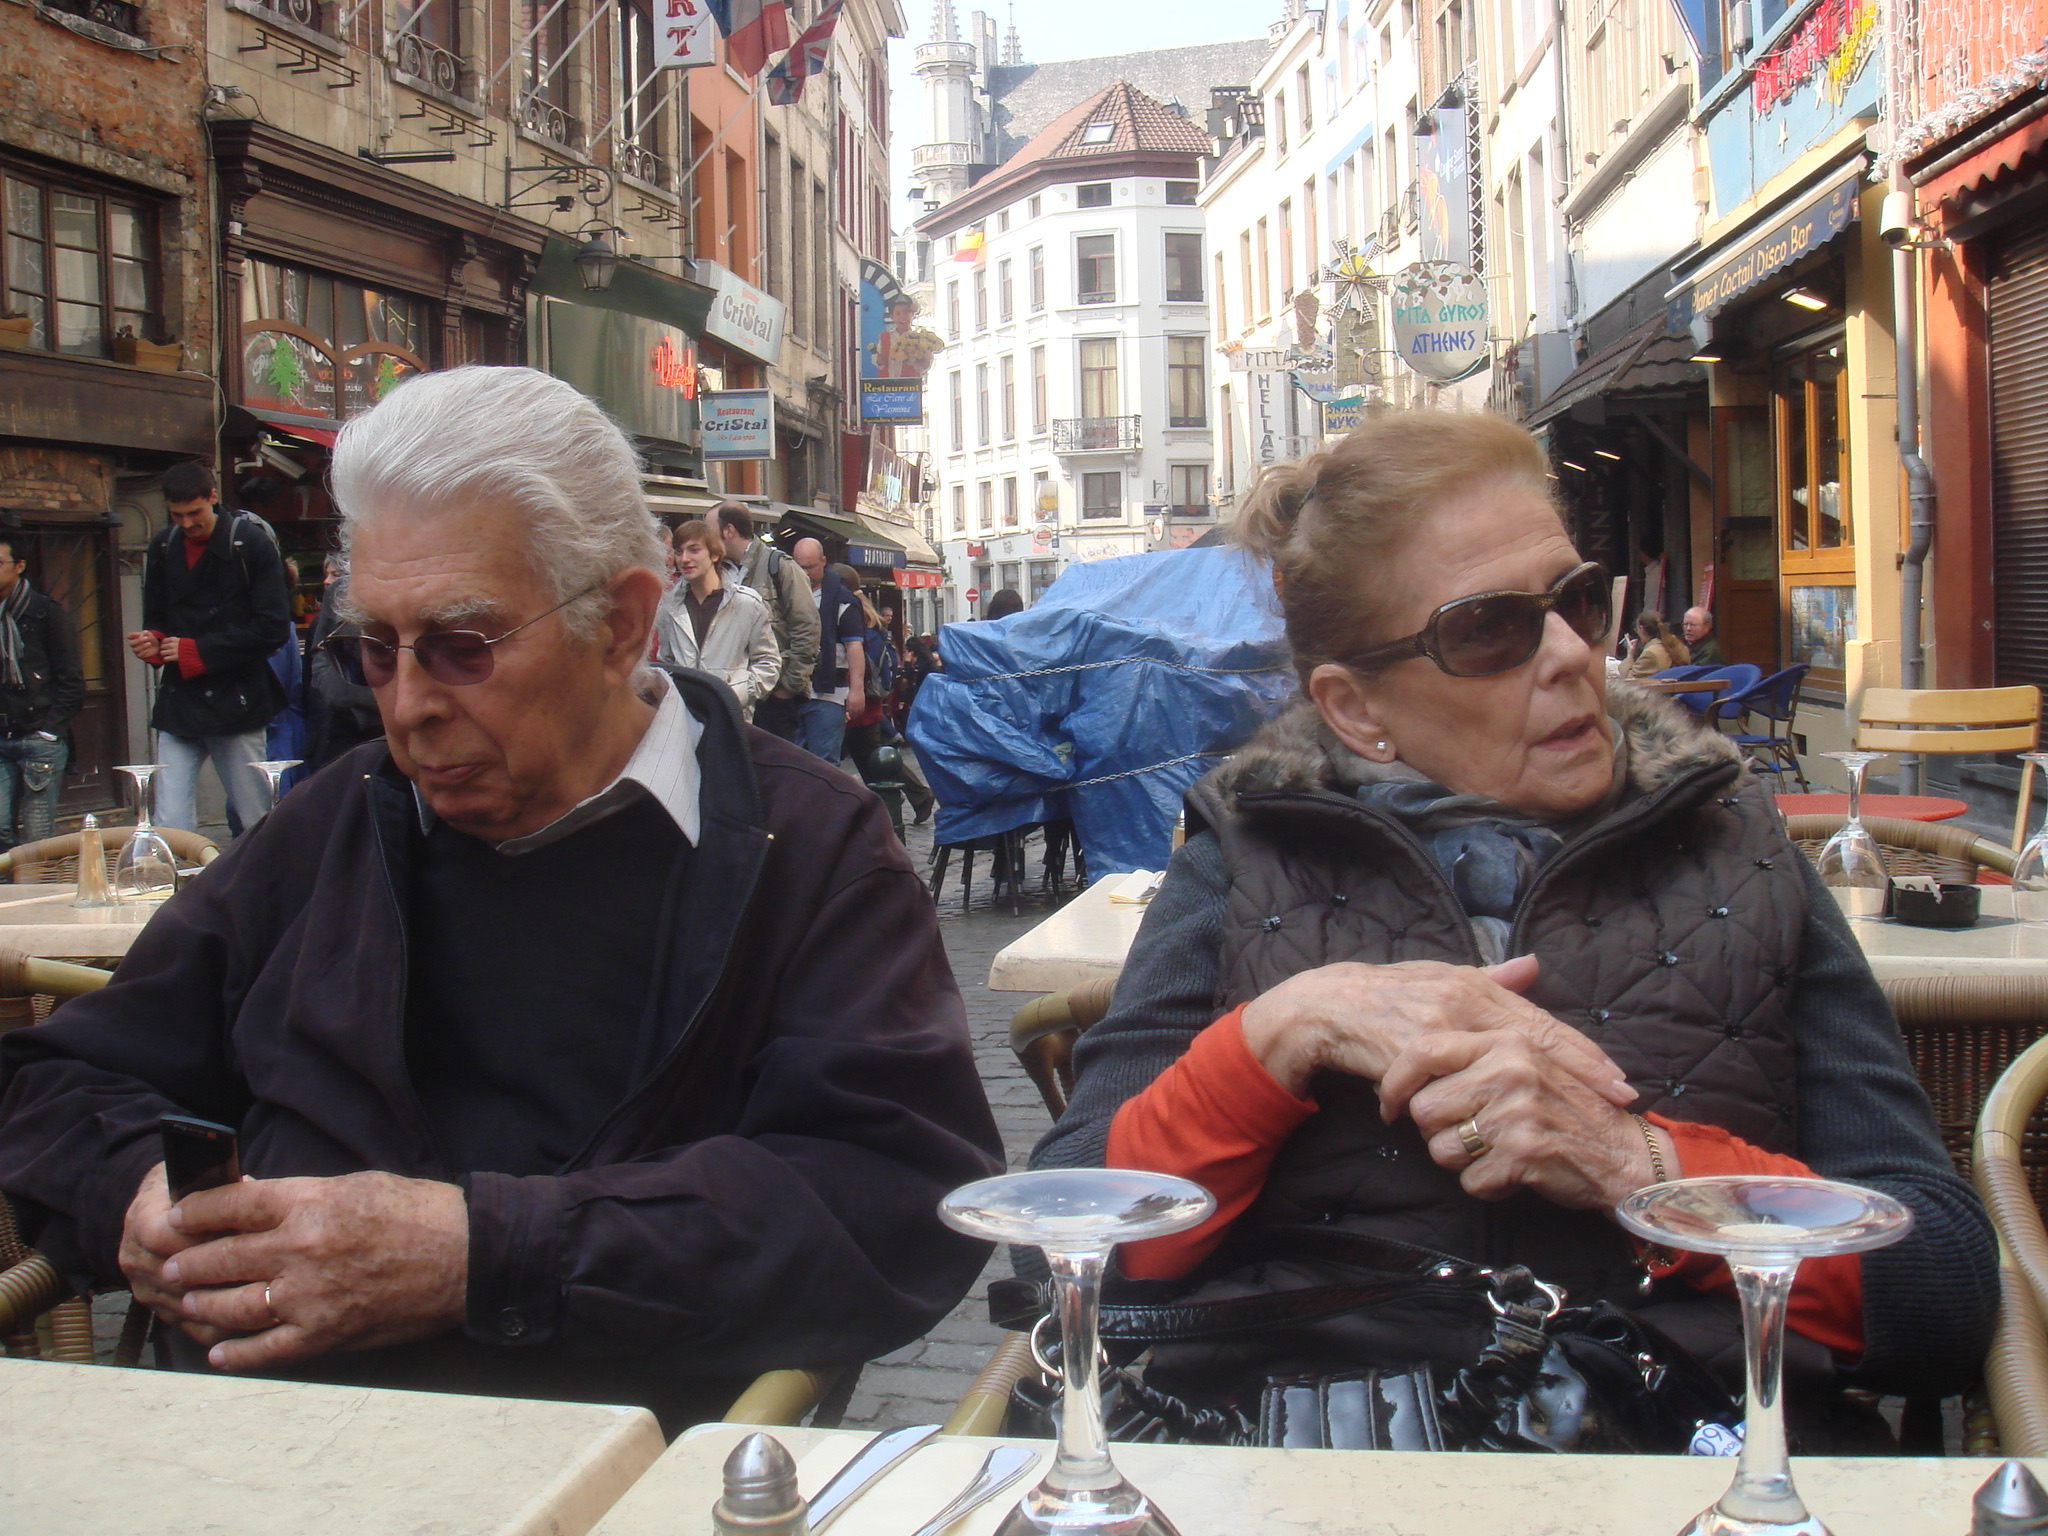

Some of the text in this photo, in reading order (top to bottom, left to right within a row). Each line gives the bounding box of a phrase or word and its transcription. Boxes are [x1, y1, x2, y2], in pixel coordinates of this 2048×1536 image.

[1693, 282, 1718, 314] Planet
[1720, 253, 1754, 297] Coctail
[1756, 241, 1787, 277] Disco
[1790, 222, 1812, 254] Bar
[723, 295, 773, 342] CriStal
[1396, 303, 1485, 324] PITA GYROS
[1412, 330, 1475, 354] ATHENES
[864, 382, 919, 392] Restaurant
[717, 408, 755, 417] Restaurant
[705, 418, 768, 431] CriStal
